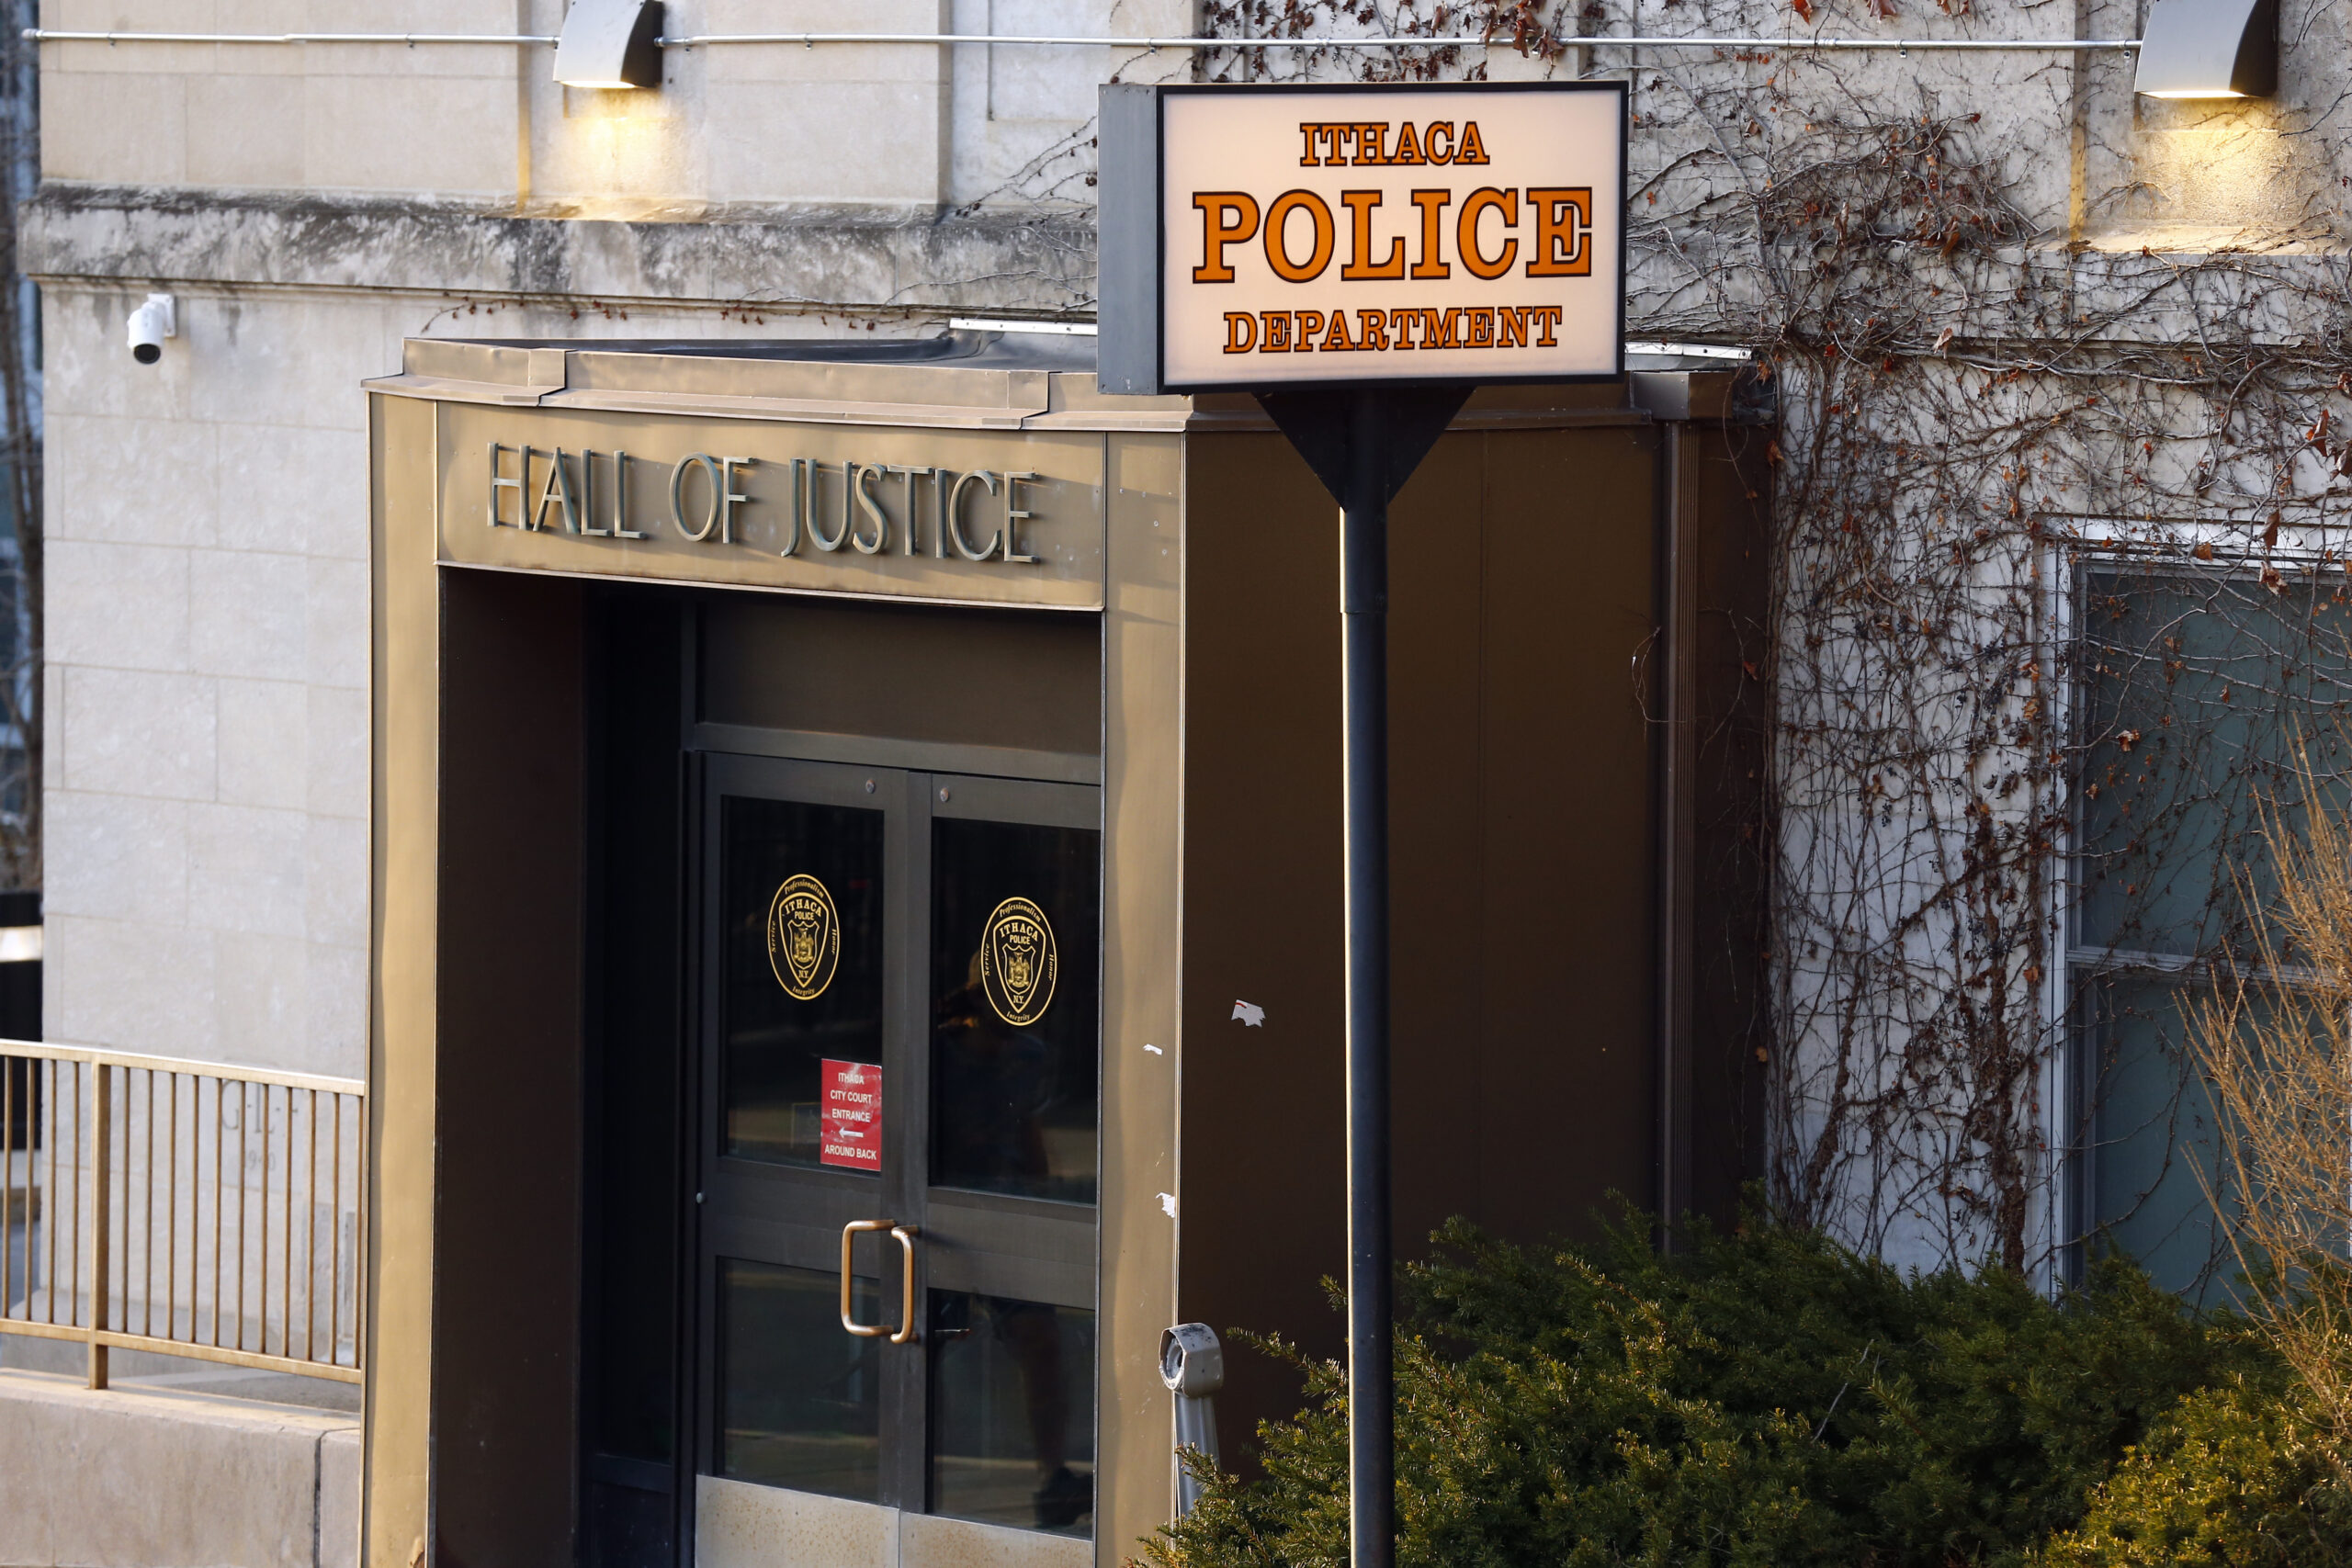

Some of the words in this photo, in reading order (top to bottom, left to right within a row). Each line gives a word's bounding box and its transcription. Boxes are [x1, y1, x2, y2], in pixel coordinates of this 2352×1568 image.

[1300, 121, 1490, 166] ITHACA
[1193, 186, 1592, 283] POLICE
[1223, 306, 1562, 354] DEPARTMENT
[487, 442, 644, 539] HALL
[670, 451, 754, 544] OF
[781, 458, 1040, 563] JUSTICE
[785, 880, 824, 898] Professionalism
[785, 898, 822, 917] ITHACA
[794, 910, 815, 920] POLICE
[999, 902, 1042, 922] Professionalism
[999, 922, 1039, 942] ITHACA
[1009, 934, 1030, 944] POLICE
[792, 986, 815, 995] Integrity
[1006, 1011, 1030, 1021] Integrity
[838, 1072, 865, 1085] ITHACA
[830, 1089, 846, 1100] CITY
[847, 1091, 873, 1104] COURT
[831, 1108, 871, 1122] ENTRANCE
[824, 1144, 855, 1157] AROUND
[856, 1148, 877, 1160] BACK
